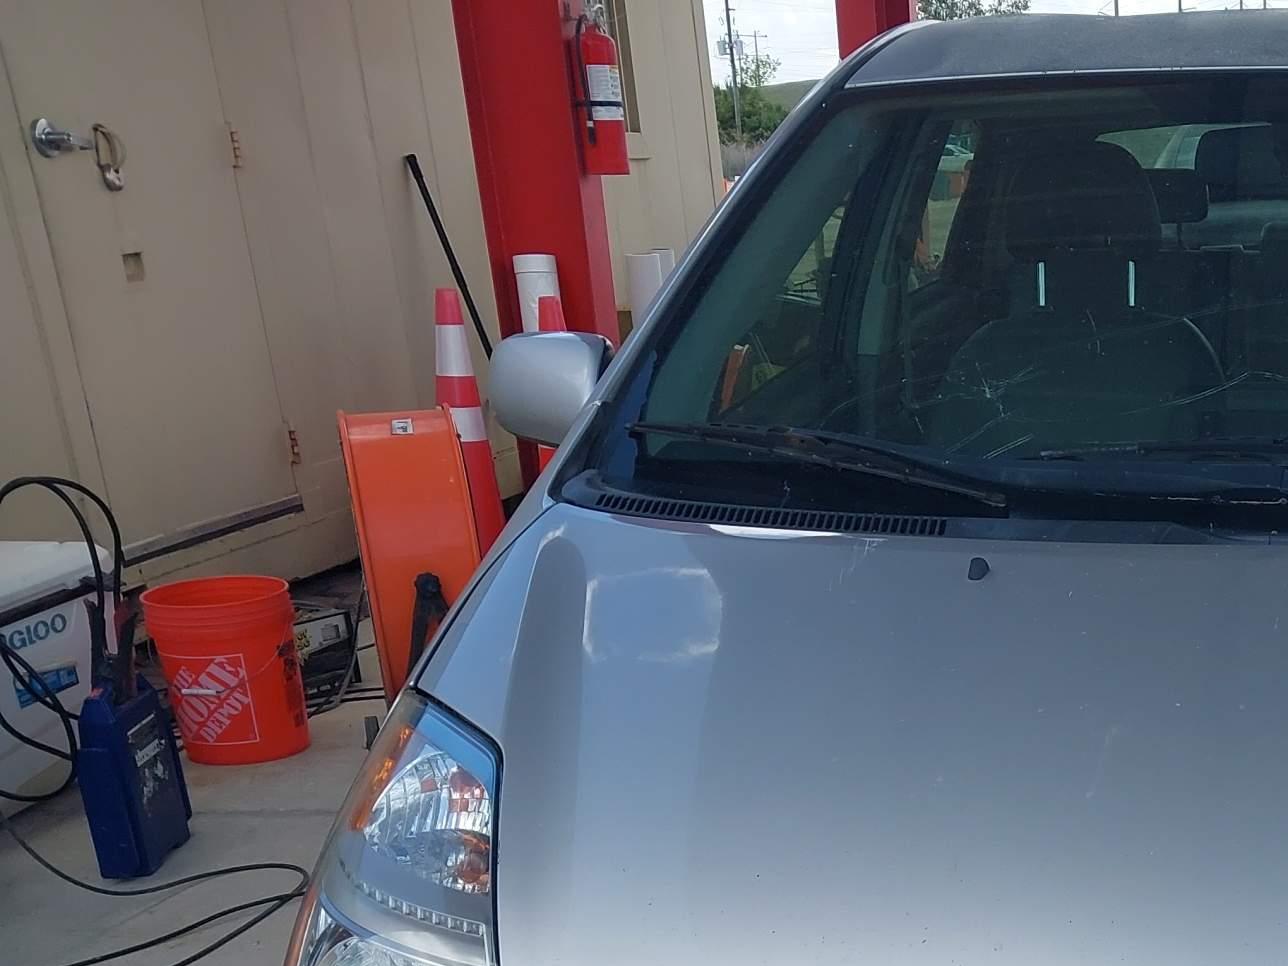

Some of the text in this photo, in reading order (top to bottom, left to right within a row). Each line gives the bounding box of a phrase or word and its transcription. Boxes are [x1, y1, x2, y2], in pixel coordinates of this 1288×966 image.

[6, 613, 67, 651] GLOO
[177, 656, 244, 738] HOME
[200, 687, 250, 743] DEPOT
